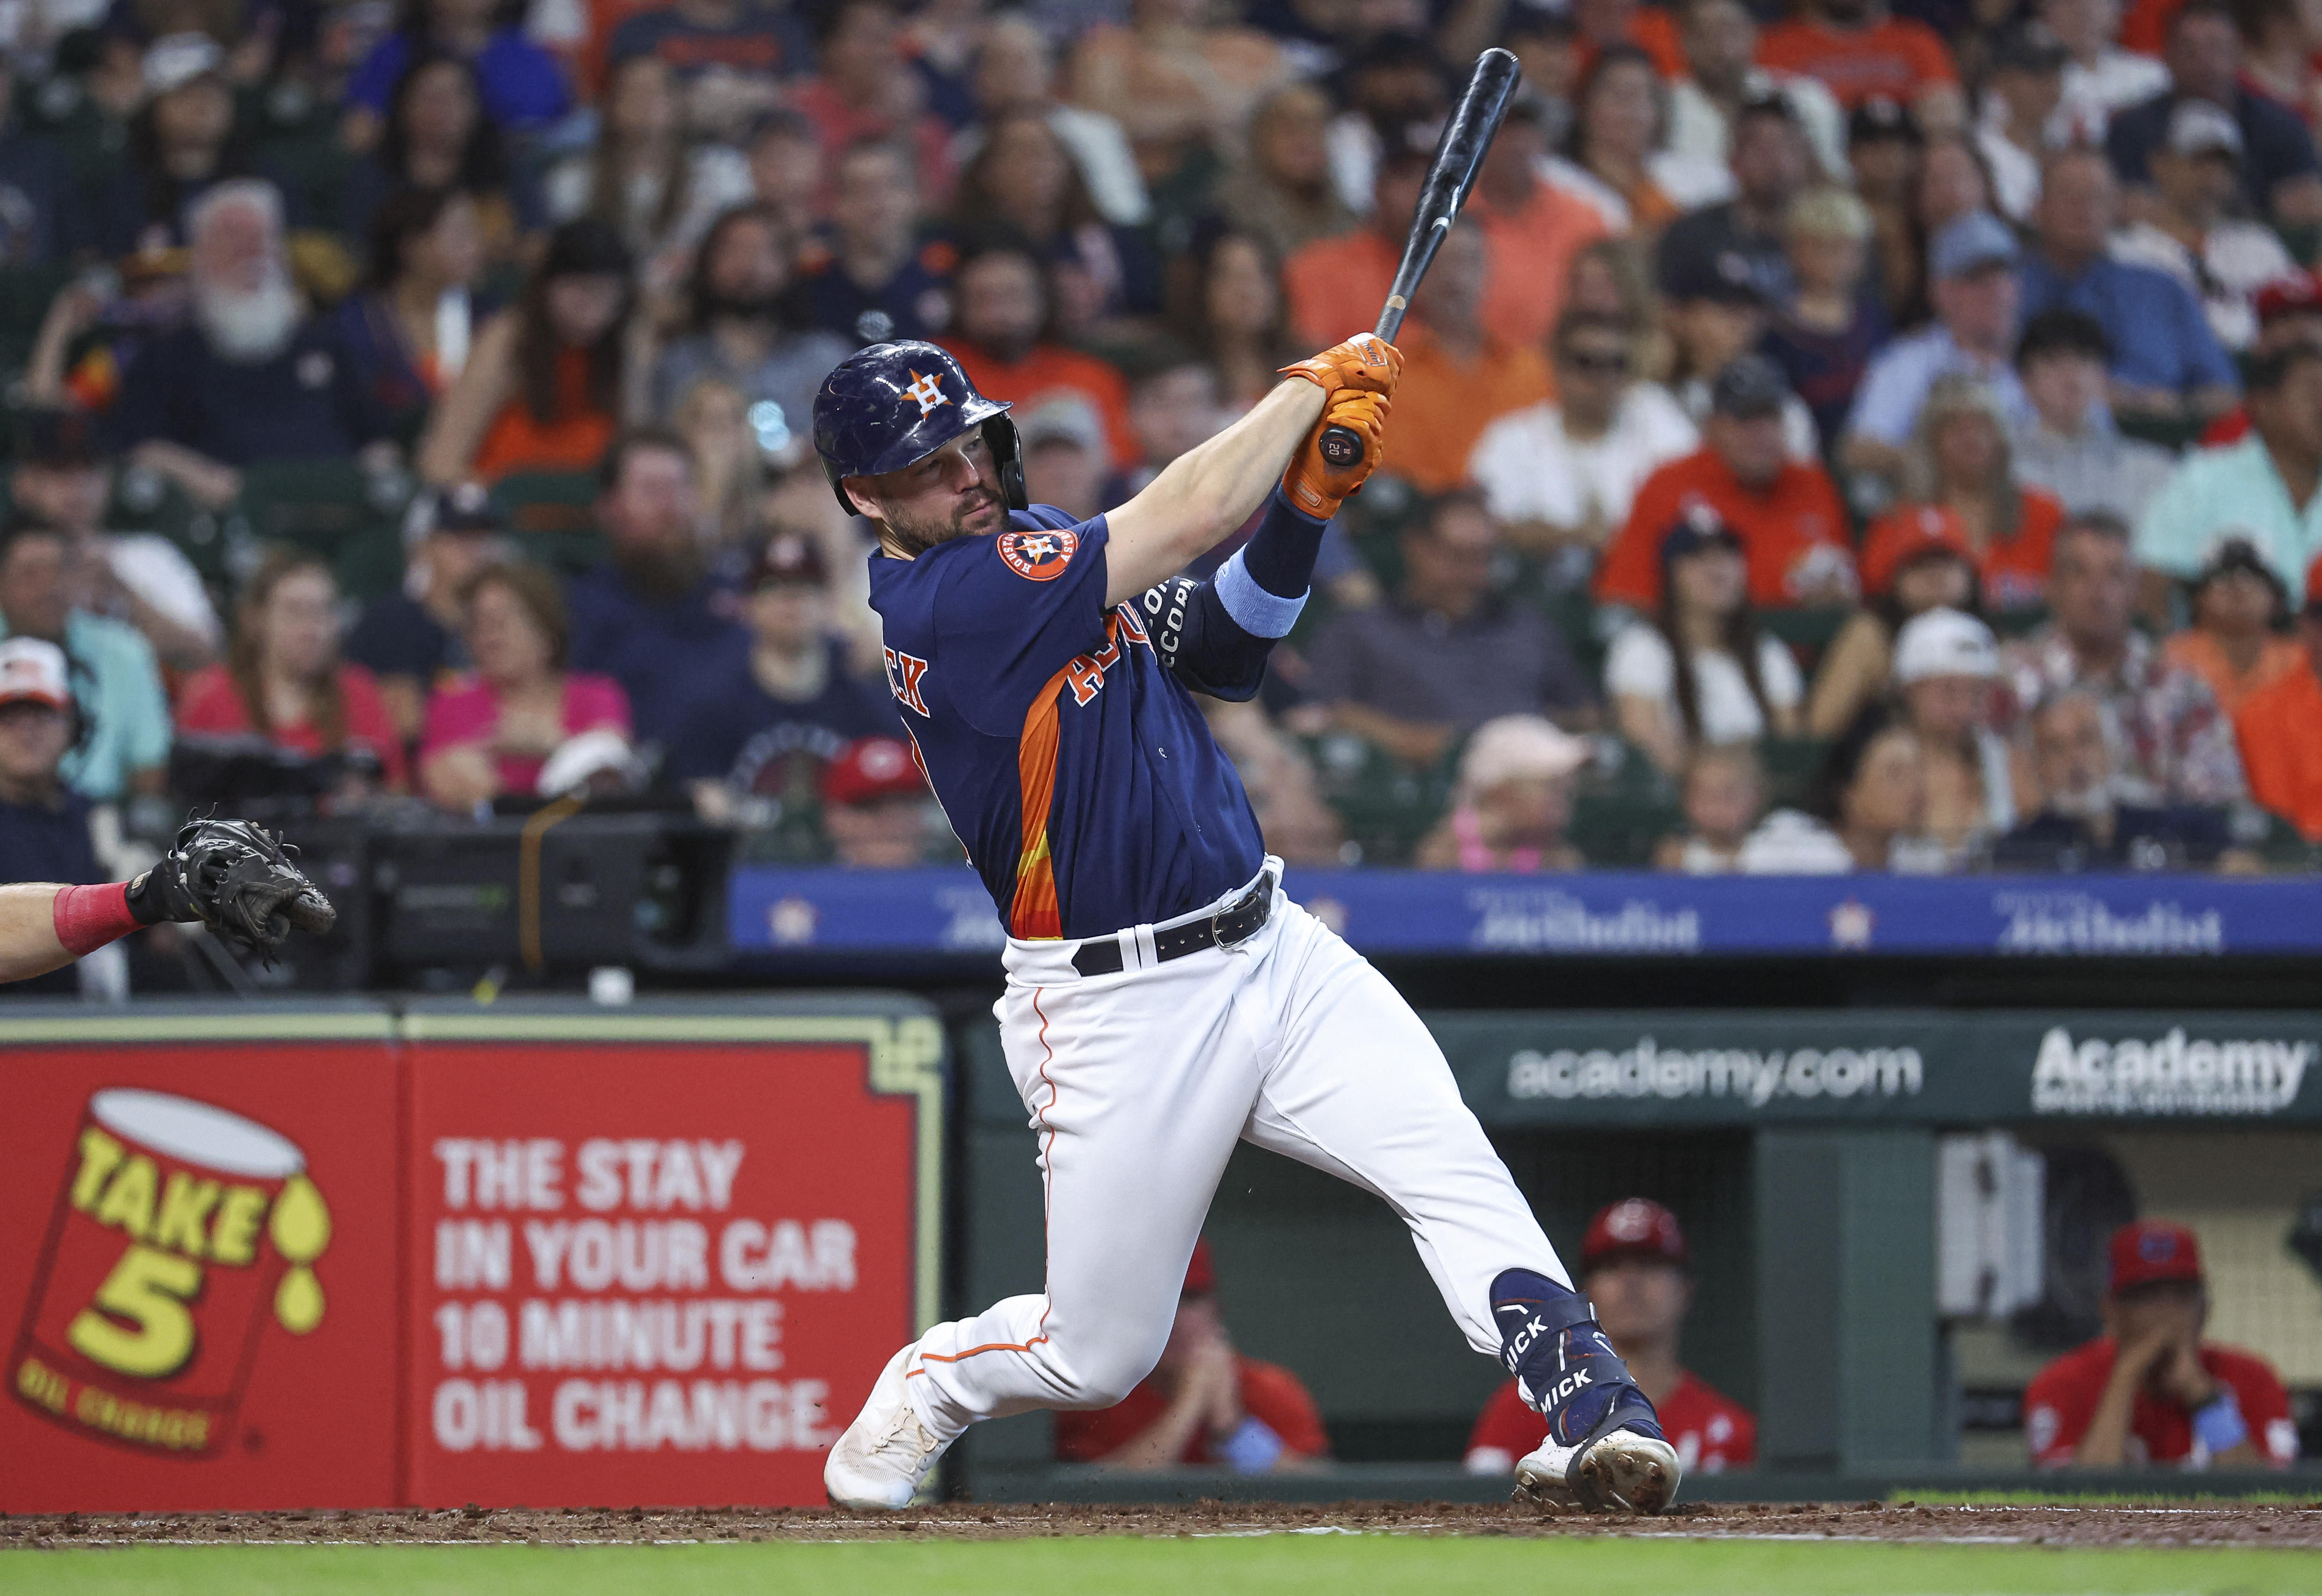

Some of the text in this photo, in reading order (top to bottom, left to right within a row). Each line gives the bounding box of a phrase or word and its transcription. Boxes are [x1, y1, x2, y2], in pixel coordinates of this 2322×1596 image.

[1328, 443, 1340, 456] 20
[1002, 533, 1033, 574] HOUSTON
[883, 645, 931, 719] CK
[1508, 1036, 1923, 1108] academy.com
[2032, 1026, 2312, 1106] Academy
[70, 1127, 269, 1267] TAKE
[432, 1137, 745, 1211] THE STAY
[434, 1218, 857, 1291] IN YOUR CAR
[66, 1243, 203, 1378] 5
[433, 1299, 786, 1372] 10 MINUTE
[432, 1378, 542, 1451] OIL
